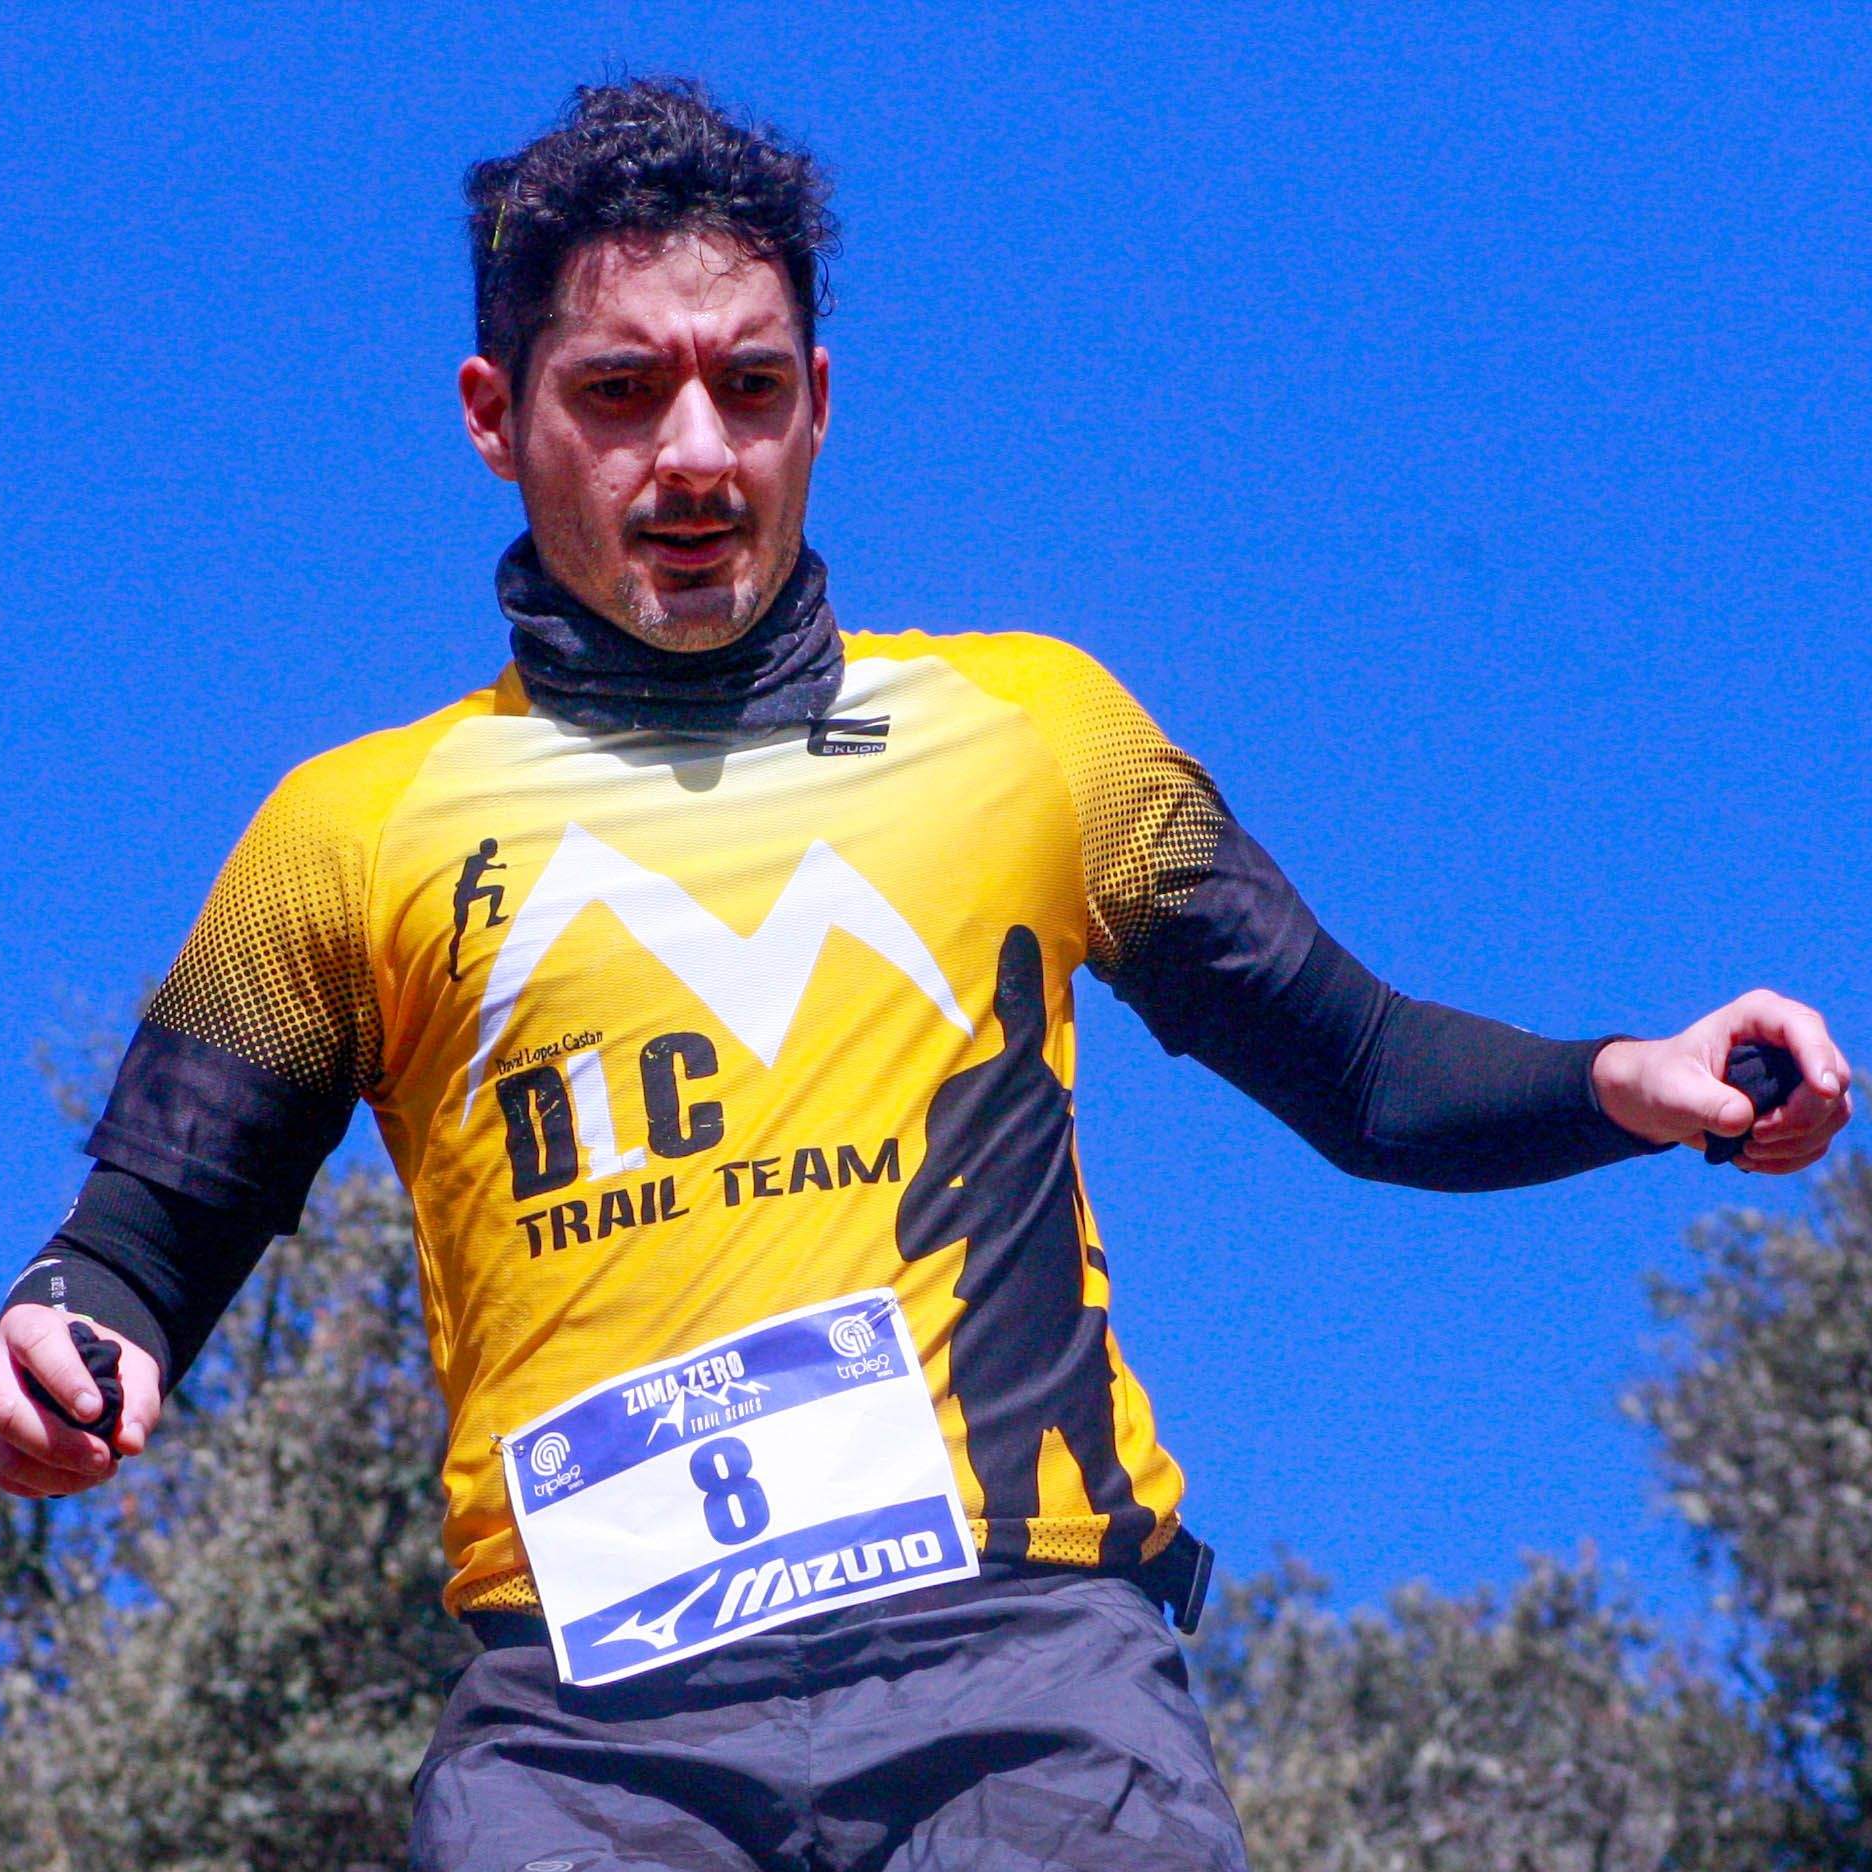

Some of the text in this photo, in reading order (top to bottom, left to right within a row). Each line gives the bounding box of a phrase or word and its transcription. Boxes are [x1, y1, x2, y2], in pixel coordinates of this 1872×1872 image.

[516, 1137, 901, 1259] TRAIL TEAM
[622, 1374, 680, 1417] ZIMA
[690, 1397, 762, 1434] TRAIL SERIES
[689, 1436, 770, 1546] 8
